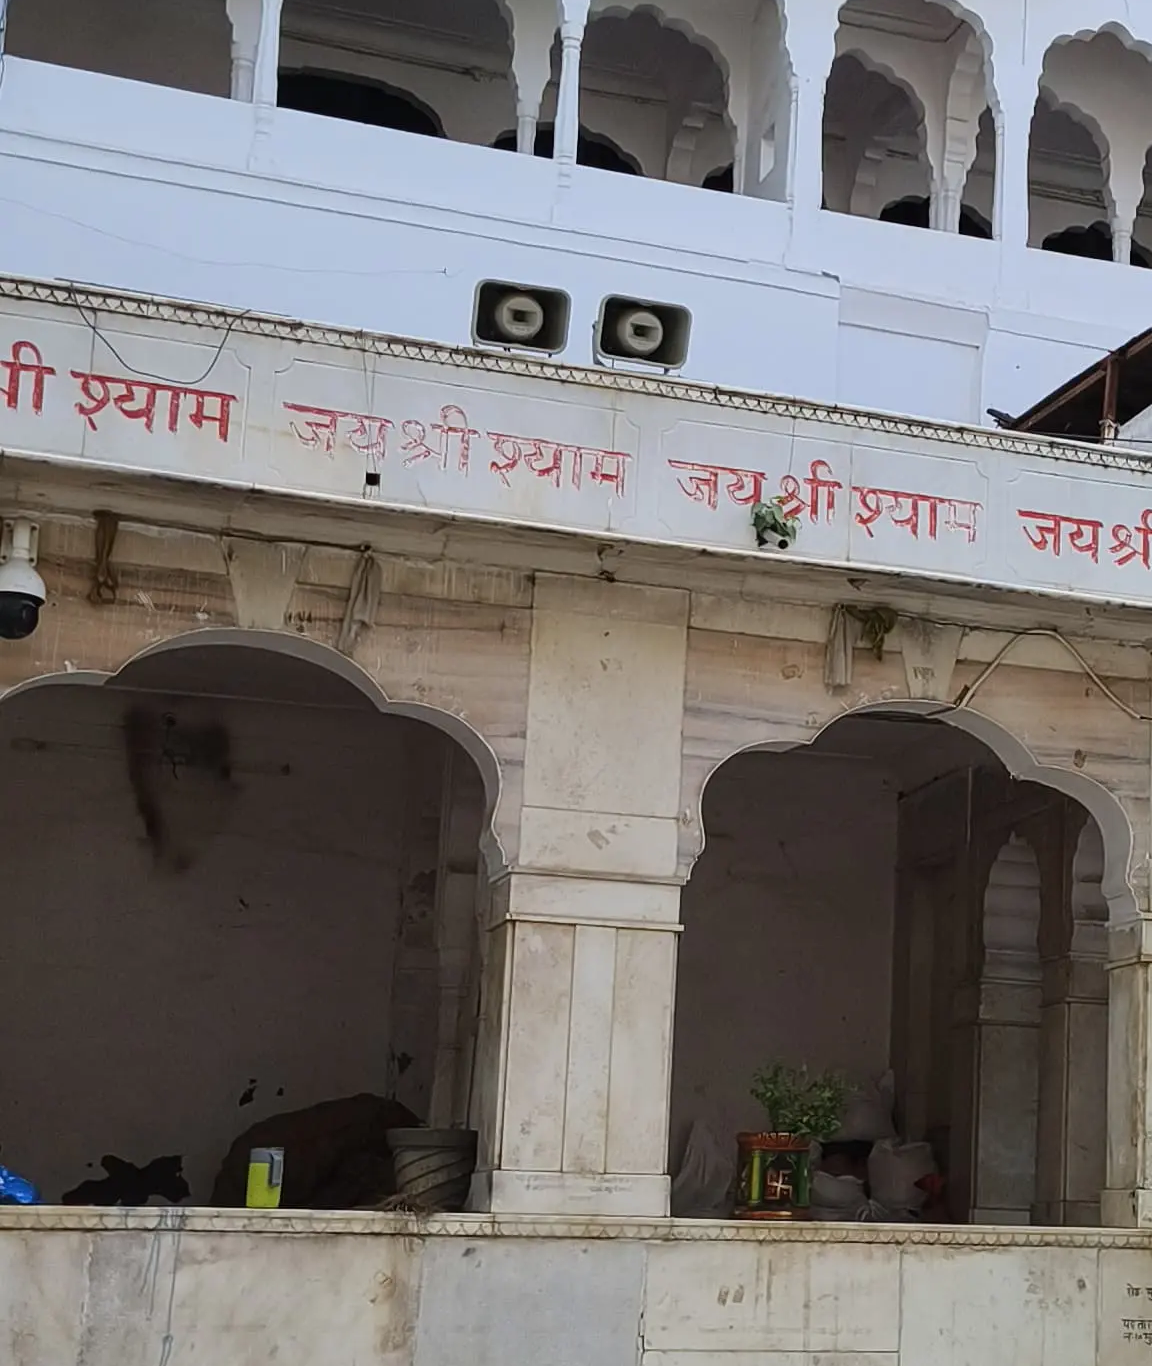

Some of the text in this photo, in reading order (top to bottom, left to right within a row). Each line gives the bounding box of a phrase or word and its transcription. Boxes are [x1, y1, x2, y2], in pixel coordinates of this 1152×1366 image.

[70, 370, 239, 443] श्याम
[282, 402, 632, 499] जय श्री श्याम
[667, 459, 983, 544] जय श्री श्याम
[1017, 509, 1103, 565] जय
